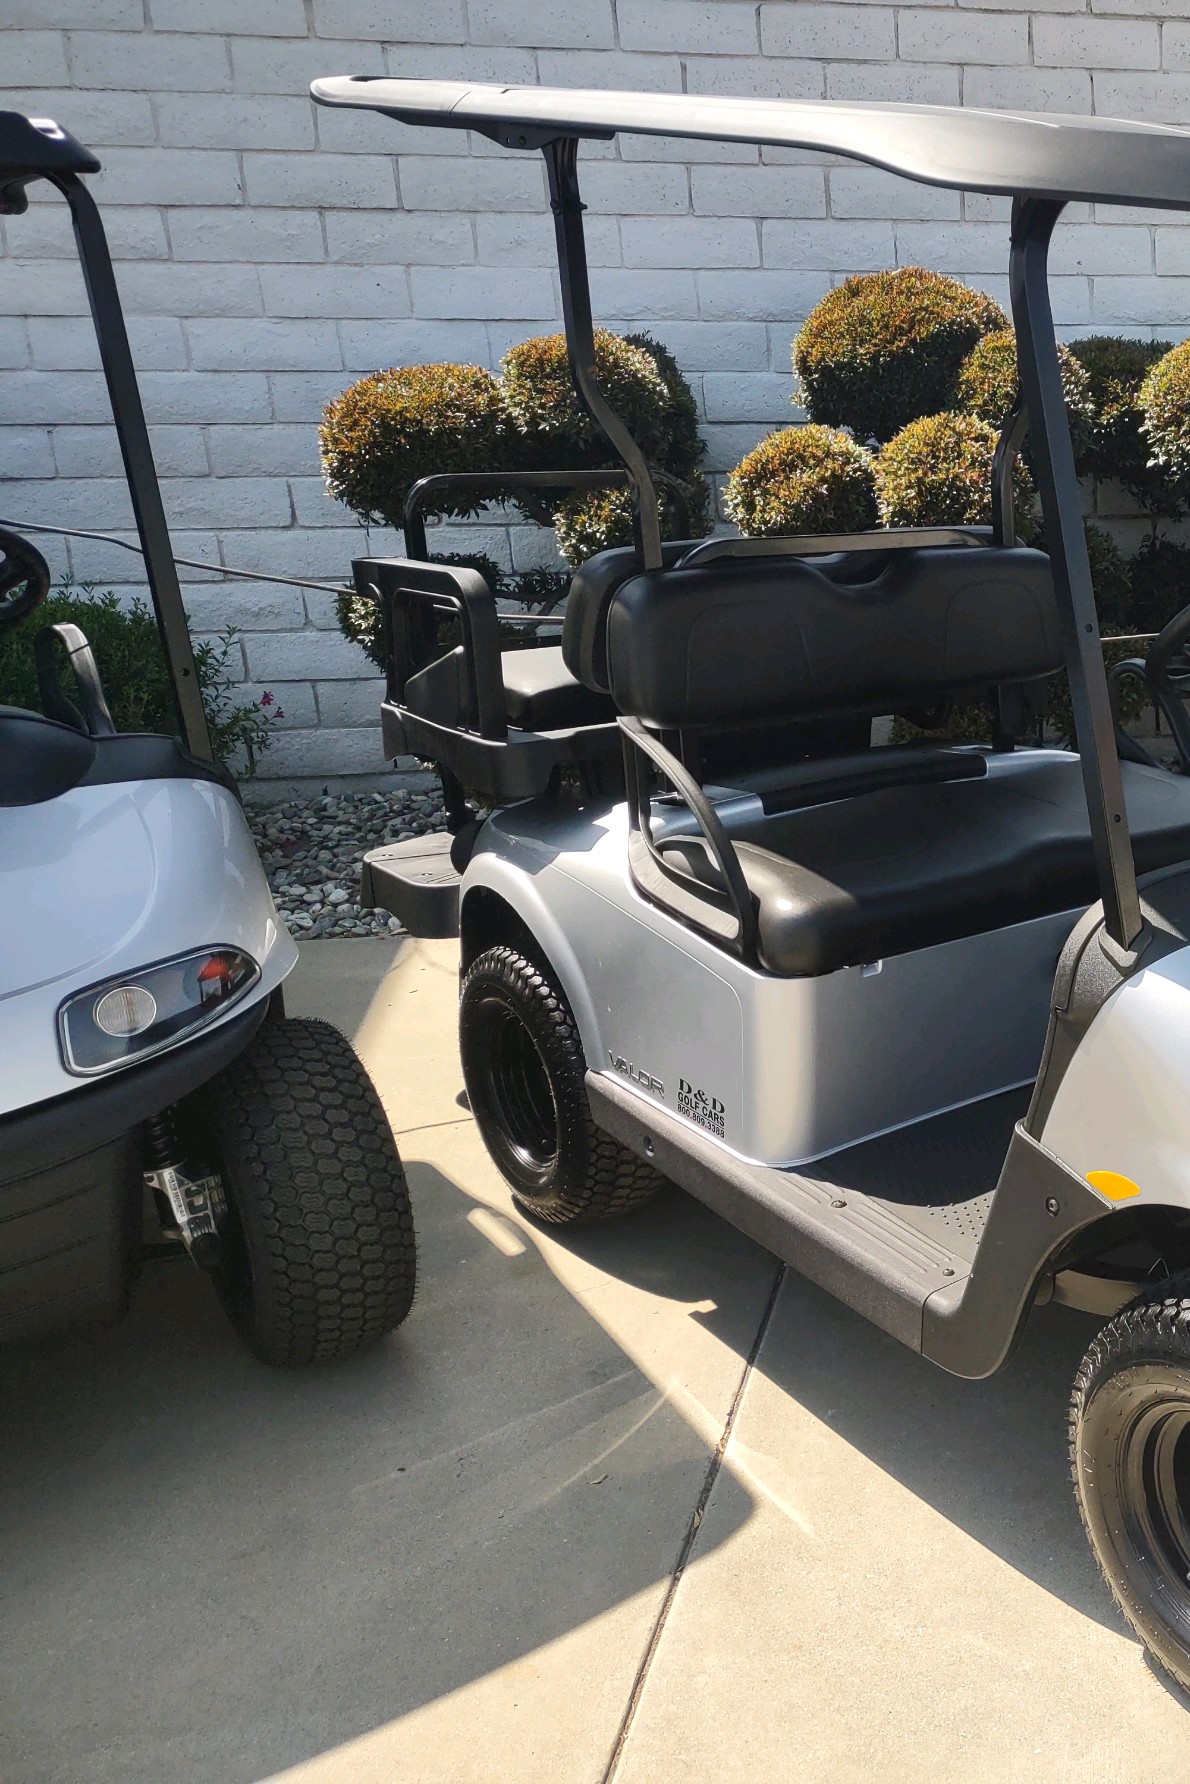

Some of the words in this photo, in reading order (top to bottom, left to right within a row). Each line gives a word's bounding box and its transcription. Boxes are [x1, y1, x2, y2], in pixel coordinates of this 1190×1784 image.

[608, 1049, 665, 1100] VALOR
[677, 1092, 700, 1111] GOLF
[701, 1106, 725, 1127] CARS
[677, 1103, 725, 1139] 800.809.3388
